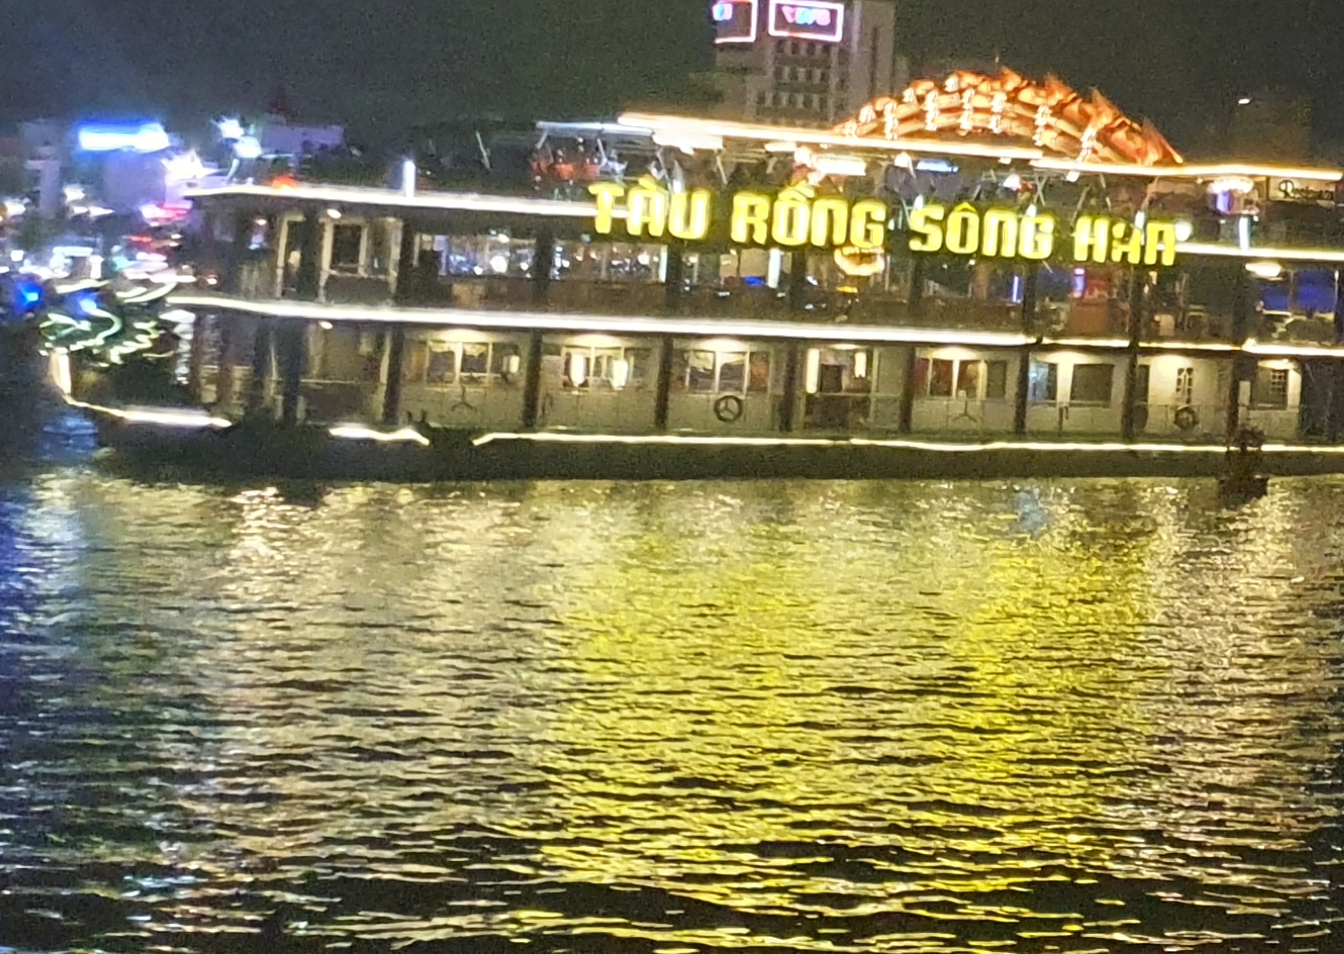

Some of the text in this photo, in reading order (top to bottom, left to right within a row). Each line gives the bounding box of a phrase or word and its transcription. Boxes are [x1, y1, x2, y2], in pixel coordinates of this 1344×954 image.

[588, 173, 712, 240] TÀU
[730, 178, 887, 248] RỒNG
[909, 201, 1054, 260] SÔNG
